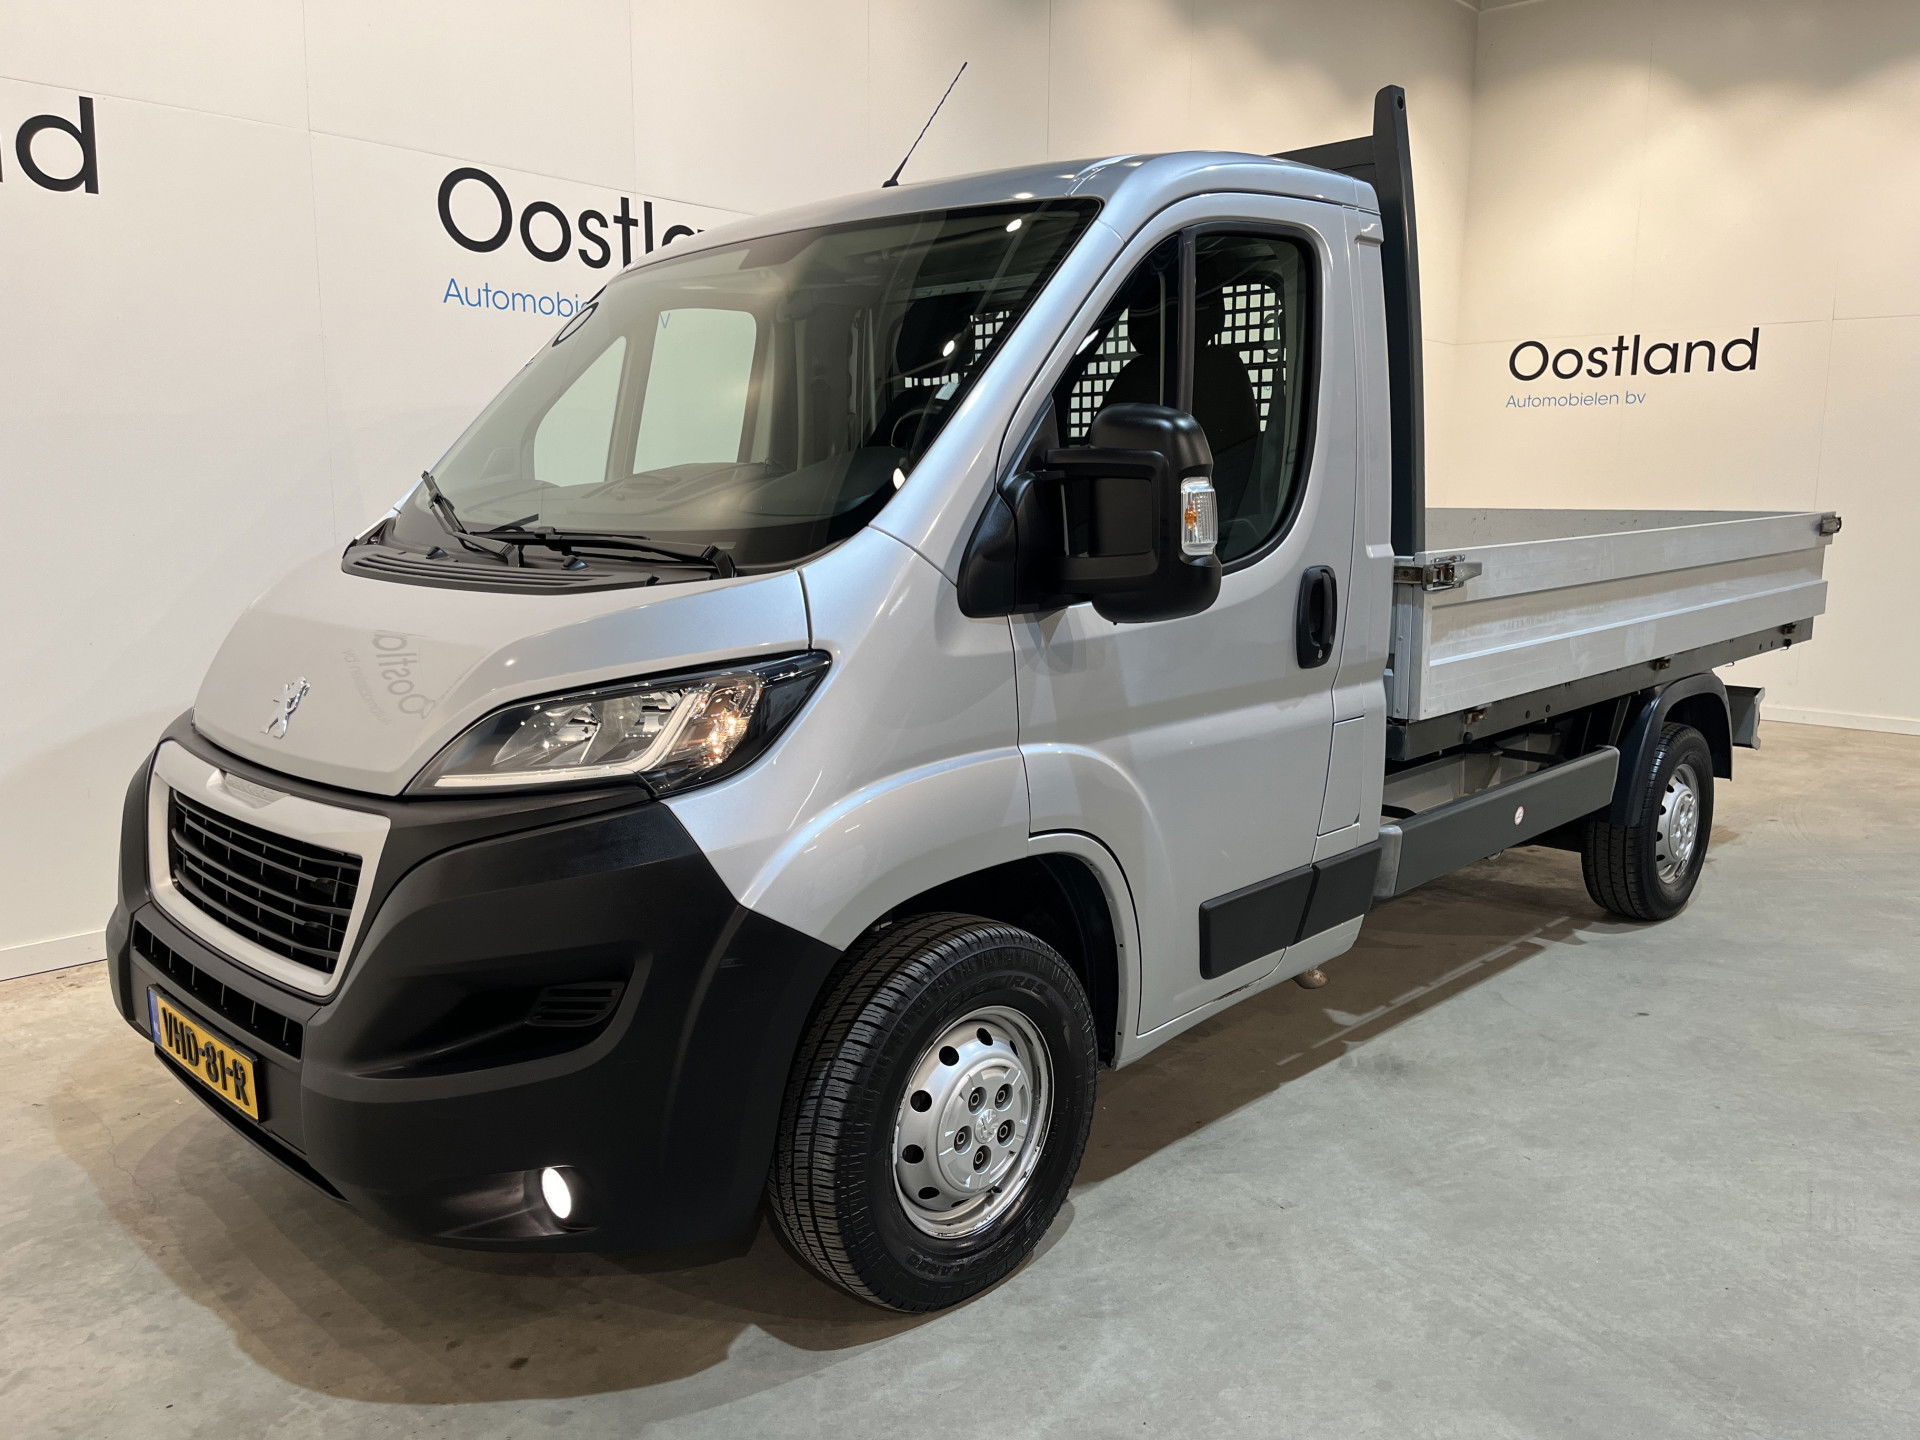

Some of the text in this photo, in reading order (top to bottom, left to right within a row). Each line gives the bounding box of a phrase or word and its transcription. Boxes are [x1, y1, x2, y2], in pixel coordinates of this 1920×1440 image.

[1508, 326, 1760, 382] Oostland
[1505, 390, 1647, 408] Automobielen bv
[160, 1006, 250, 1107] VHD-81-R
